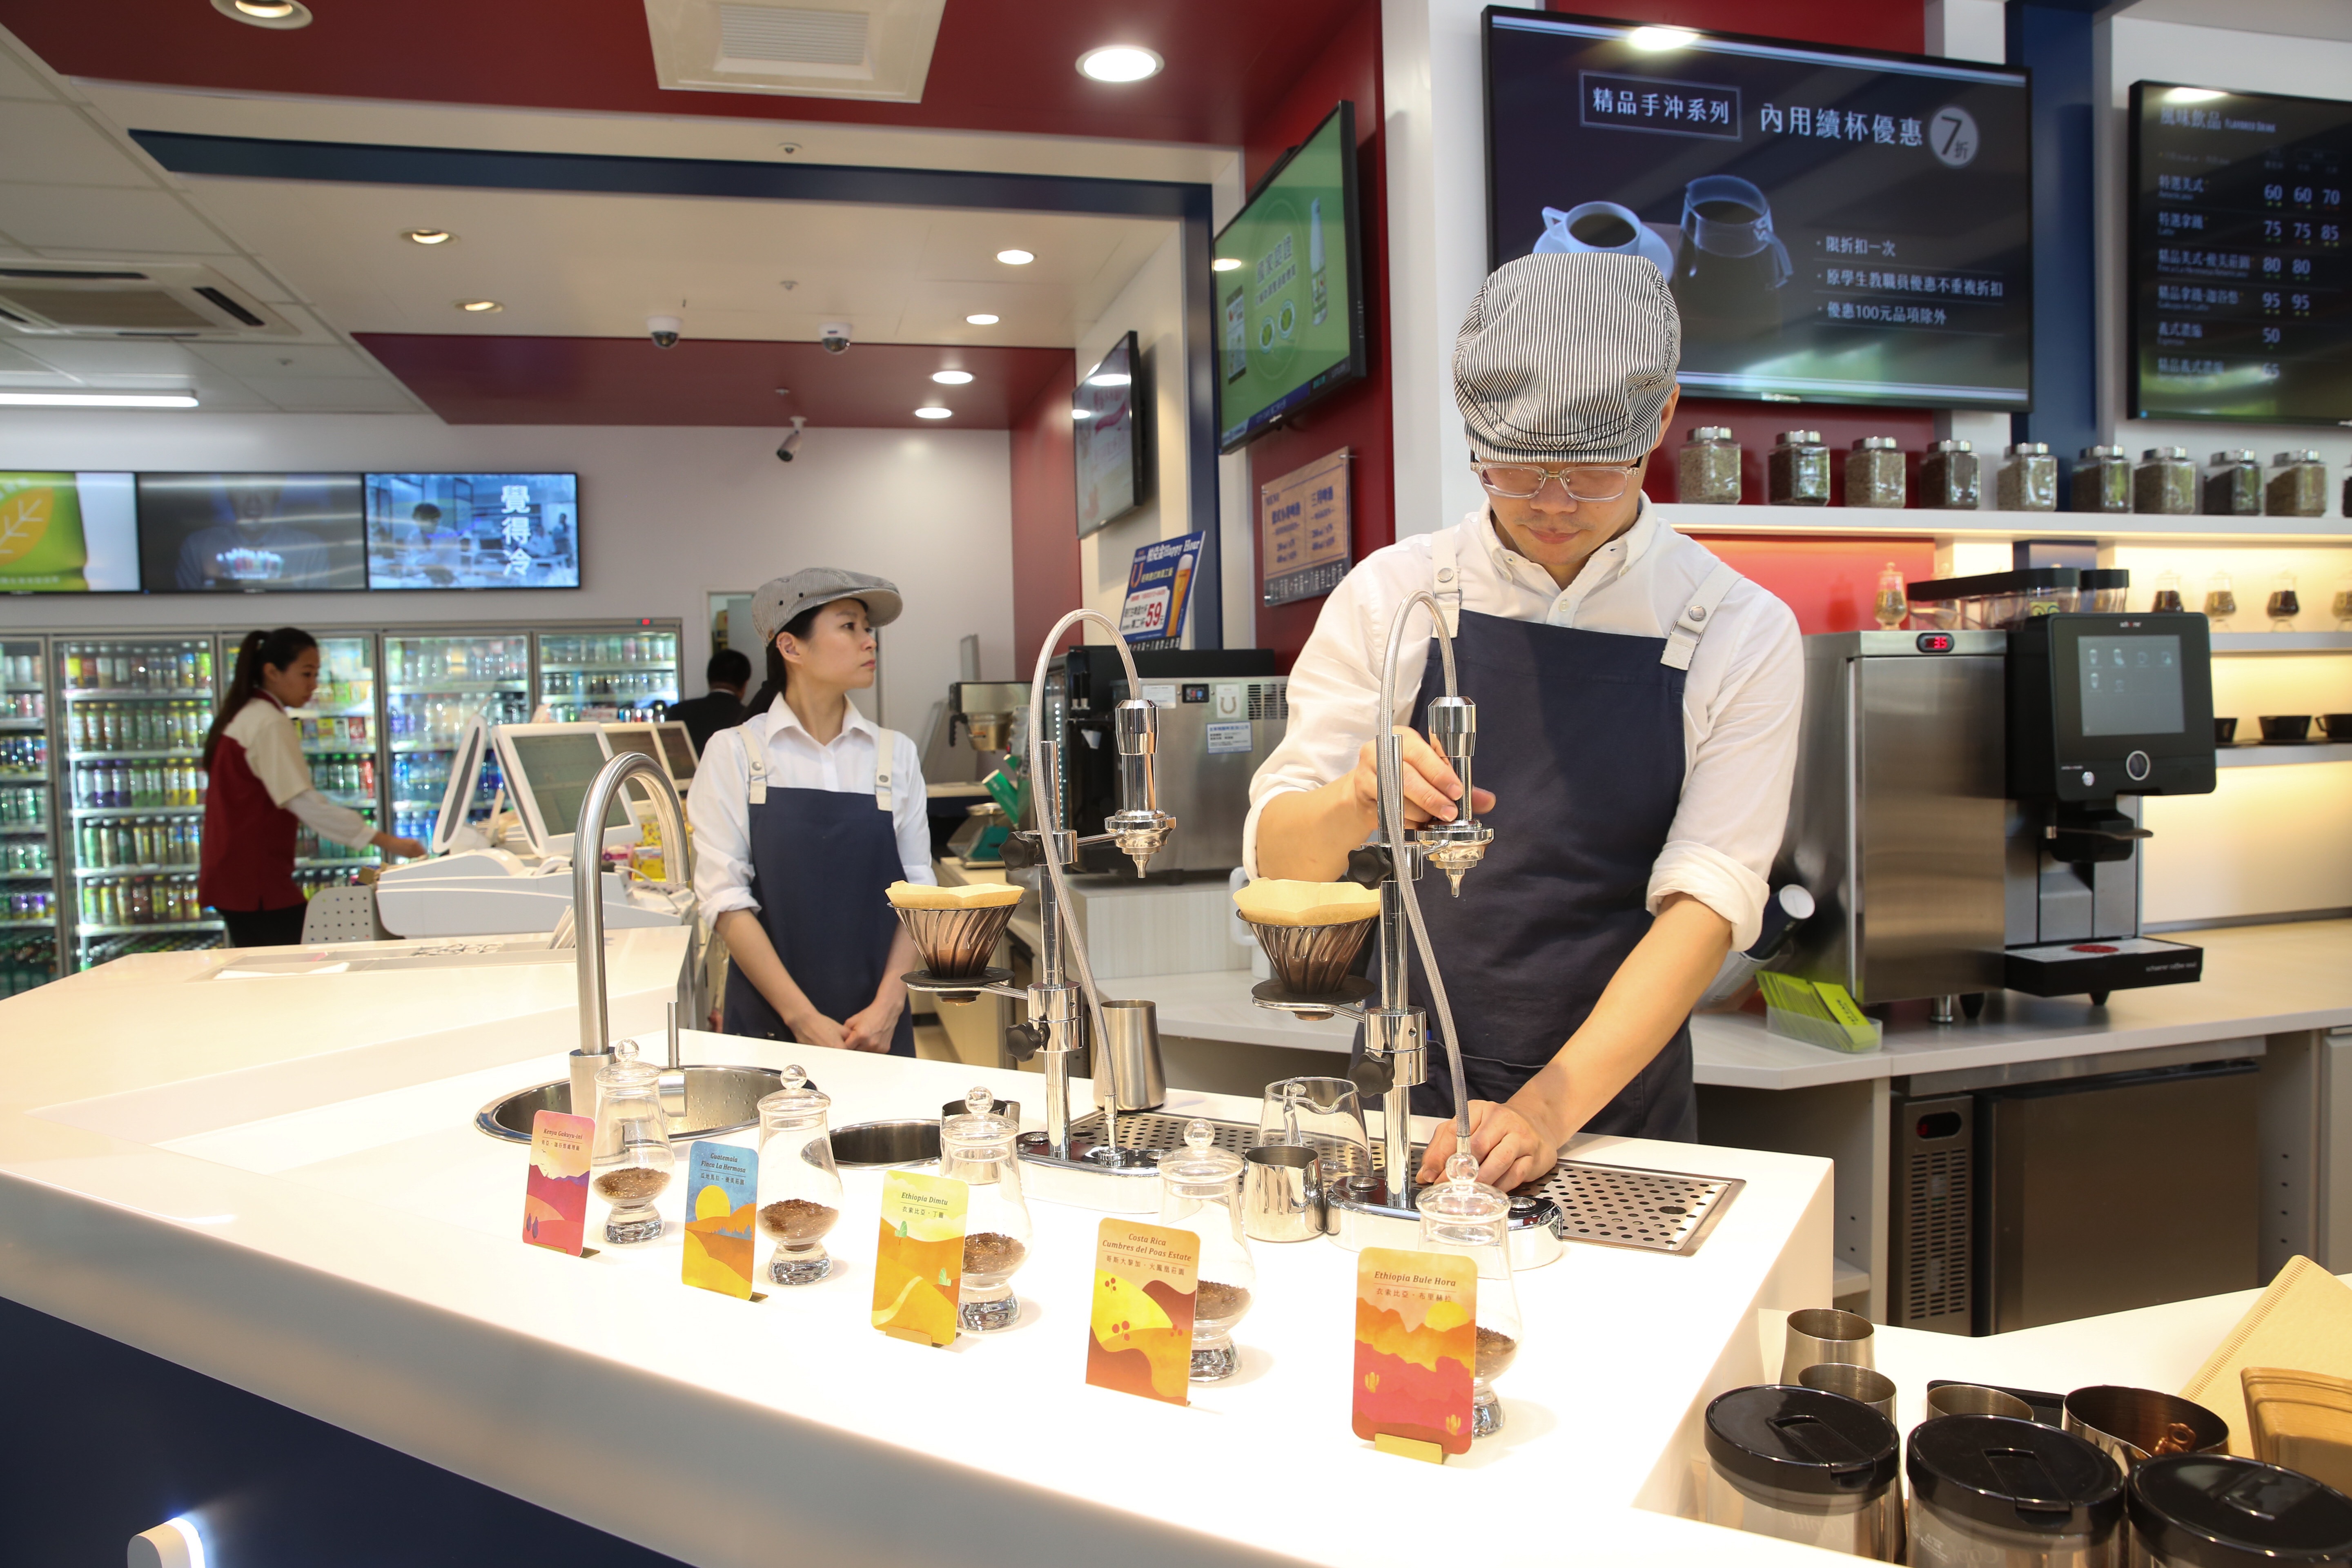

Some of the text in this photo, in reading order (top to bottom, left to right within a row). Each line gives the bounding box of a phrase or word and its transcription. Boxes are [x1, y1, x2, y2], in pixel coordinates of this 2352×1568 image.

[1592, 86, 1729, 125] 精品手沖系列
[1760, 102, 1923, 147] 內用續杯優惠
[2264, 184, 2340, 205] 60 60 70
[2264, 220, 2339, 241] 75 75 85
[1826, 236, 1896, 257] 限折扣一次
[2263, 256, 2311, 275] 80 80
[2262, 292, 2310, 310] 95 95
[1827, 301, 1947, 325] 優惠100元品項除外
[2262, 327, 2281, 343] 50
[501, 485, 531, 576] 覺得冷
[1145, 602, 1162, 627] 59
[558, 1131, 583, 1139] Gakuyu-ini
[710, 1153, 737, 1162] Guatemala
[723, 1164, 746, 1173] Hermosa
[902, 1192, 948, 1205] Ethiopia Dimtu
[1129, 1234, 1166, 1246] Costa Rica
[1102, 1240, 1134, 1251] Cumbres
[1149, 1248, 1166, 1257] Poas
[1168, 1251, 1192, 1261] Estate
[1374, 1271, 1456, 1286] Ethiopia Bule Hora
